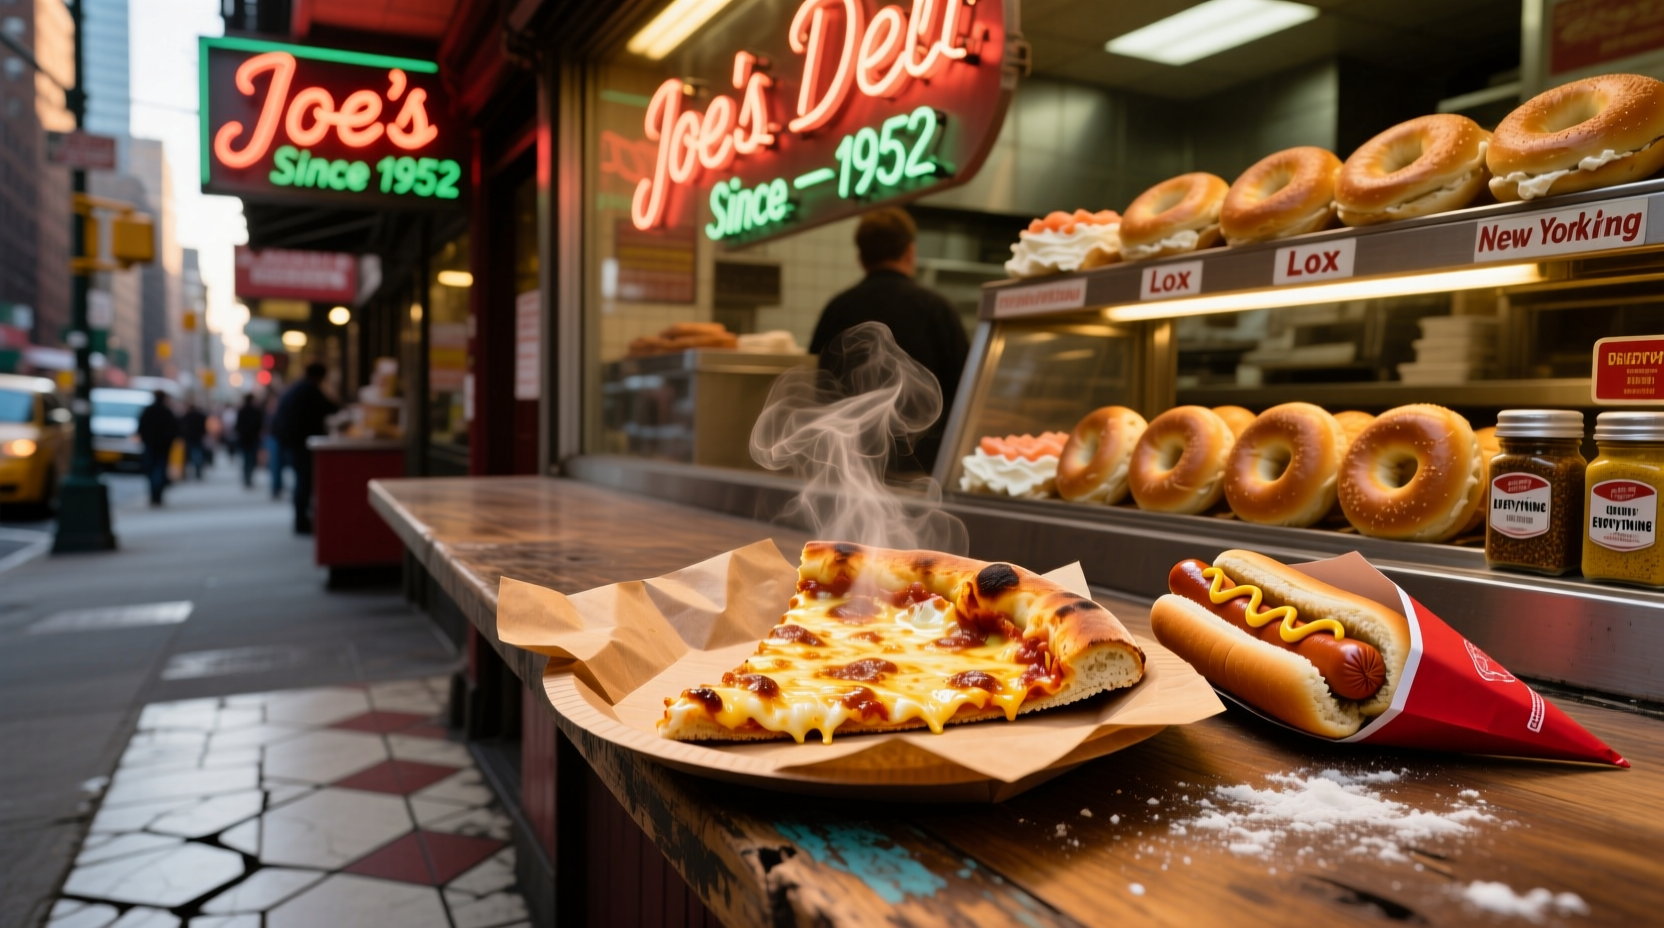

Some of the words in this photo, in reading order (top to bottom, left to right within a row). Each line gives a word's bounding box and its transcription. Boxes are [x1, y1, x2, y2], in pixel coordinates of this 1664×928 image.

[214, 52, 438, 168] Joe's
[631, 49, 775, 231] Joe's
[269, 145, 370, 193] Since
[377, 155, 461, 199] 1952
[705, 176, 789, 241] Since
[1478, 224, 1533, 252] New
[1540, 209, 1642, 245] Yorking
[1150, 270, 1191, 294] Lox
[1286, 250, 1341, 277] Lox
